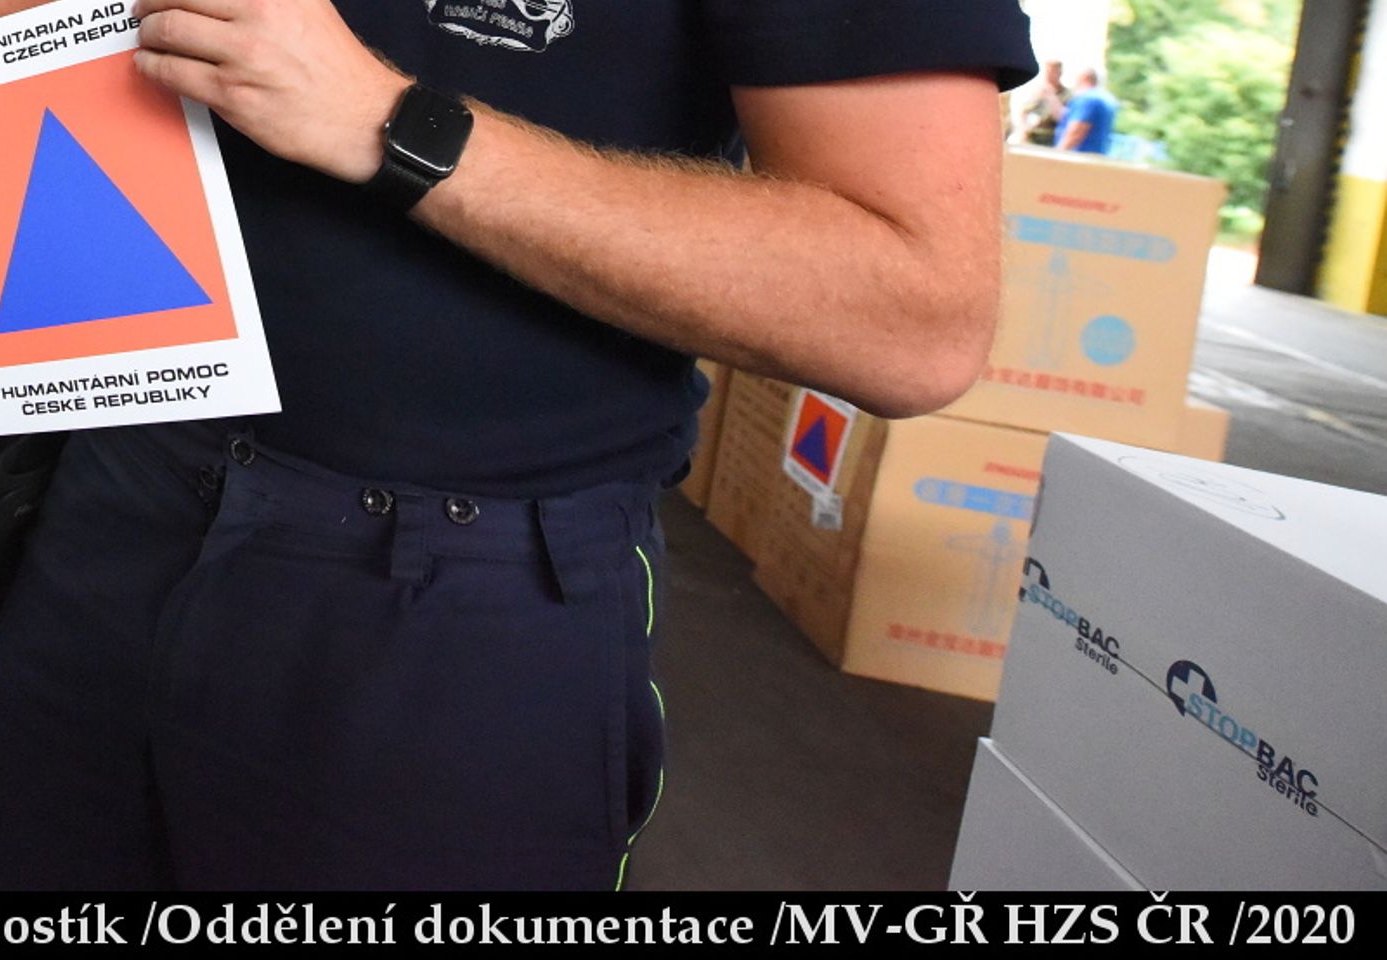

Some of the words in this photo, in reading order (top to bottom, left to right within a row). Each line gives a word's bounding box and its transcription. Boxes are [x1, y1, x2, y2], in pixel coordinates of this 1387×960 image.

[90, 1, 125, 22] AID
[3, 37, 67, 66] CZECH
[73, 16, 141, 45] REPUB
[1, 369, 141, 401] HUMANITÁRNÍ
[146, 362, 230, 384] POMOC
[21, 394, 87, 416] ČESKÉ
[93, 384, 212, 409] REPUBLIKY
[1025, 582, 1121, 660] STOPBAC
[1075, 637, 1119, 676] Sterile
[1184, 693, 1320, 800] STOPBAC
[1256, 763, 1320, 817] Sterile
